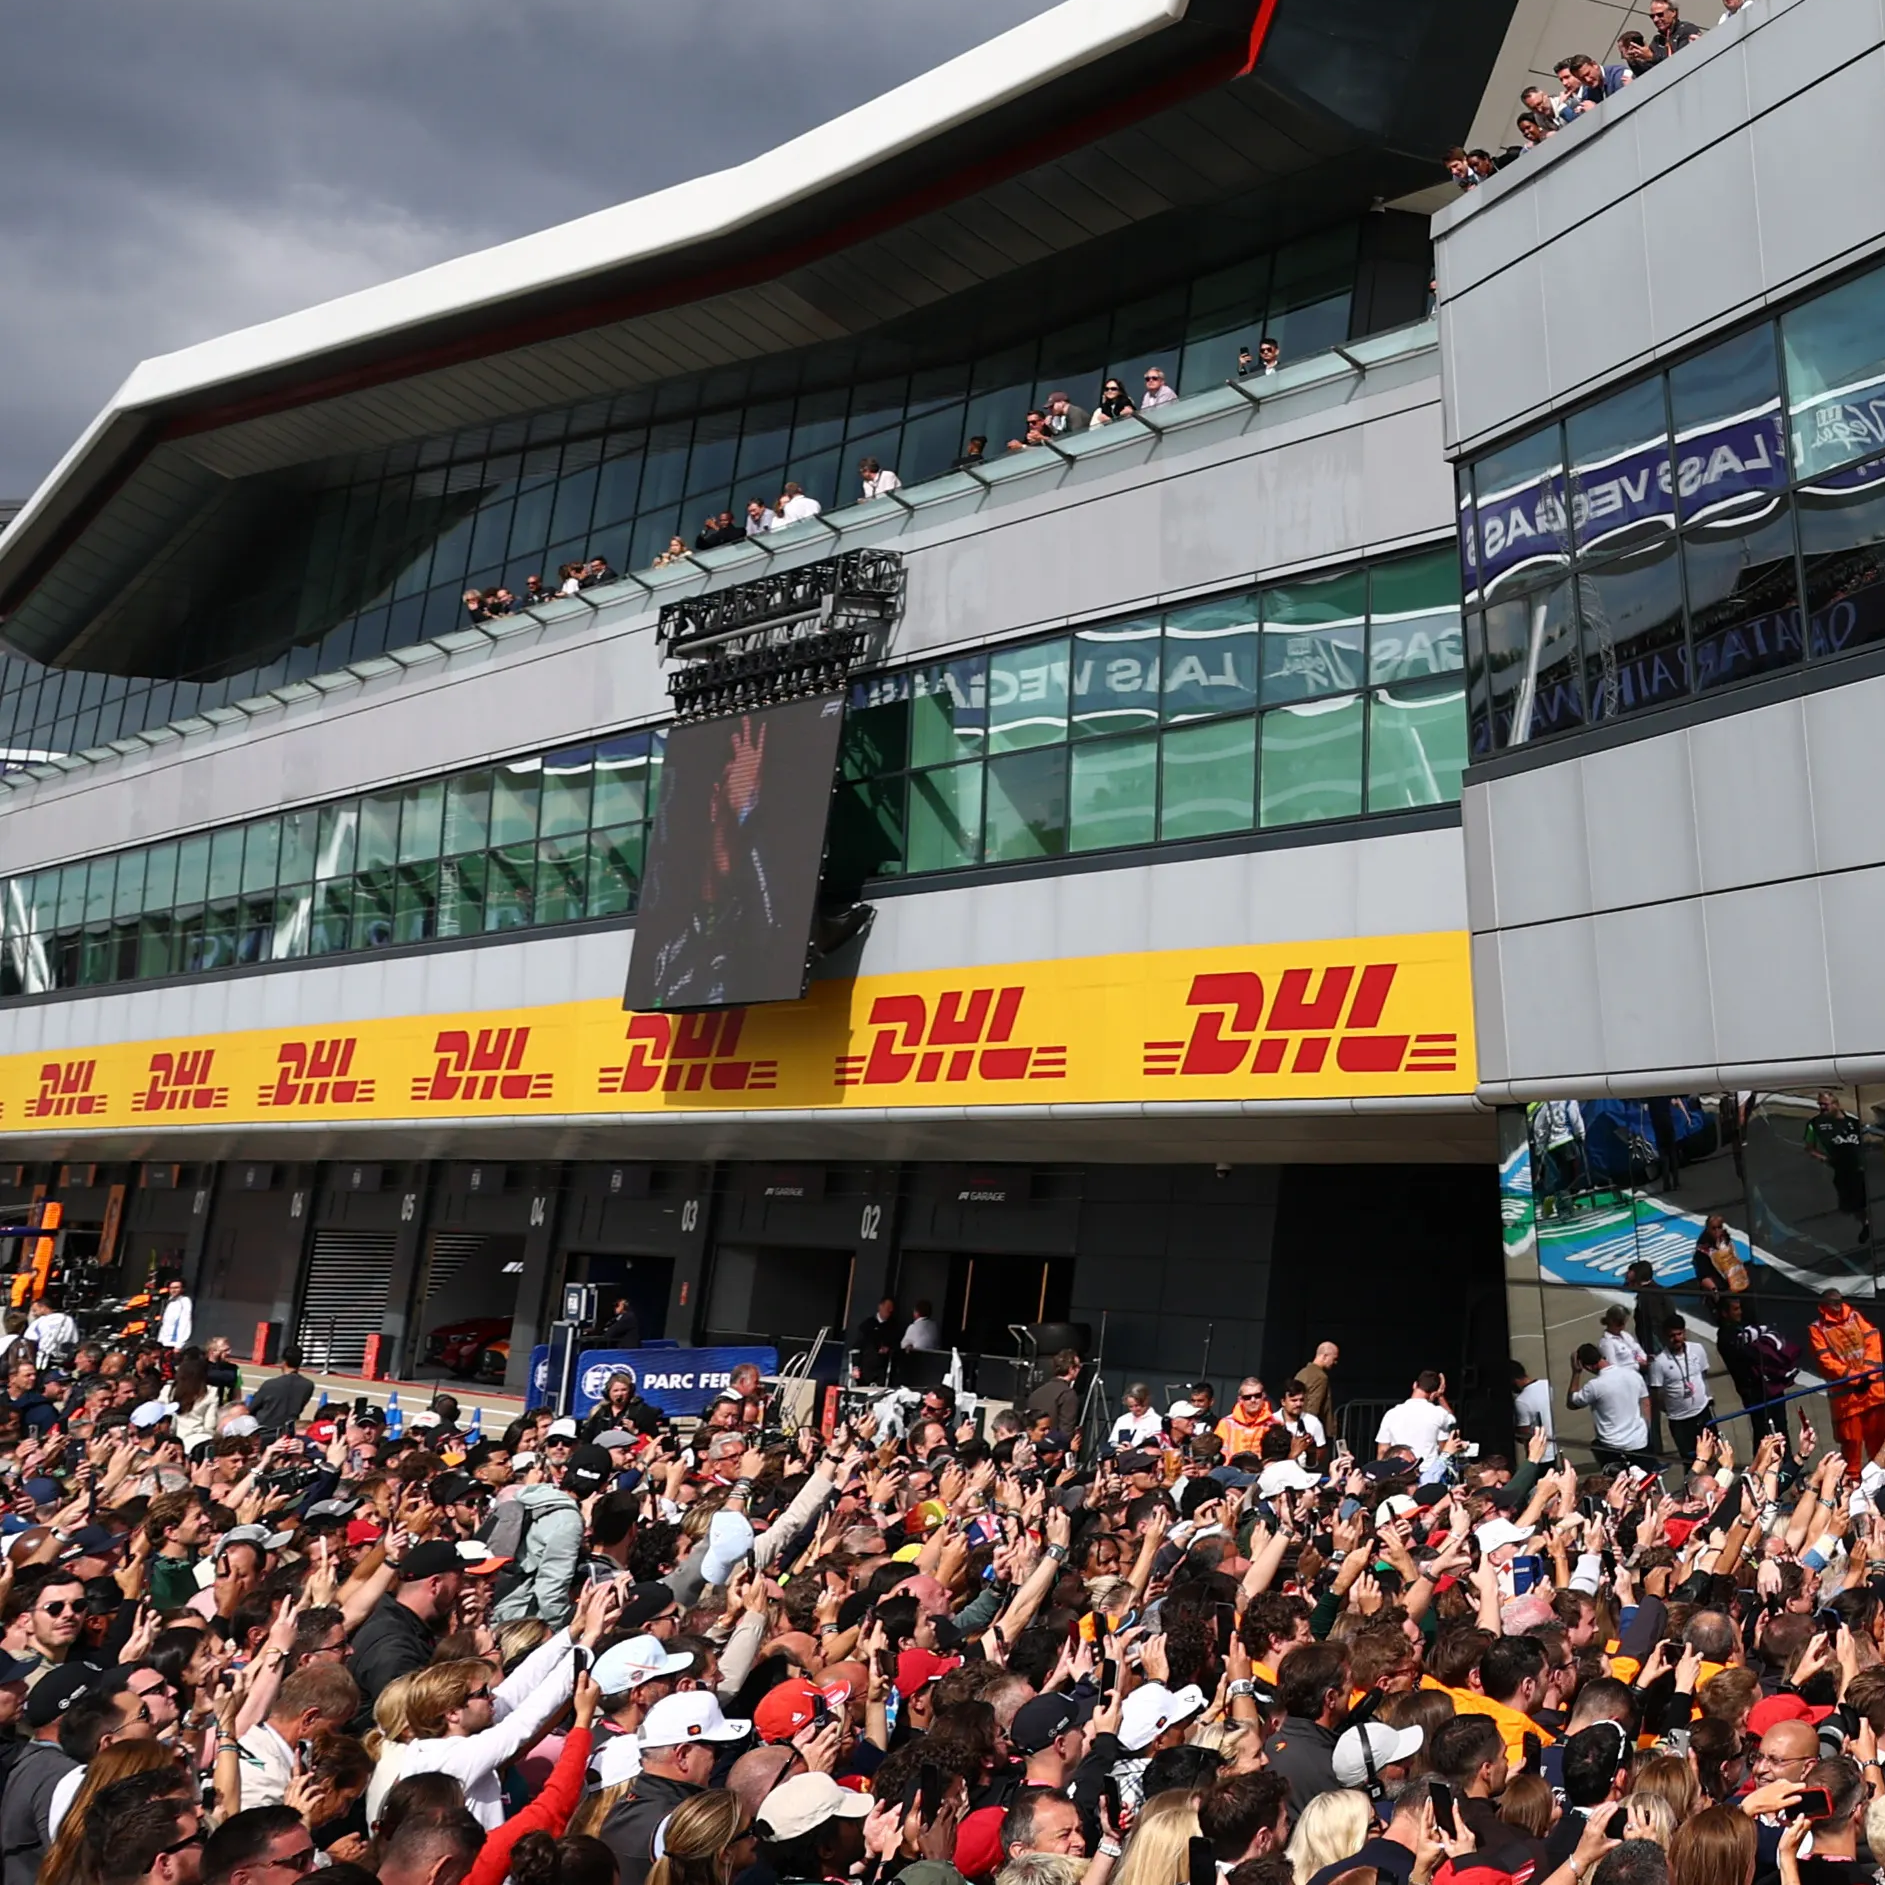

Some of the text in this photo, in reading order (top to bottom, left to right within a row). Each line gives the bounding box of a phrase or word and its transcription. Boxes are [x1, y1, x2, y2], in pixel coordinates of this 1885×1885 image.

[619, 1005, 750, 1092] DHL
[862, 986, 1033, 1084] DHL
[1180, 963, 1411, 1076] DHL
[36, 1059, 97, 1117] DHL
[145, 1049, 215, 1112] DHL
[272, 1037, 358, 1106] DHL
[428, 1026, 531, 1100] DHL
[530, 1197, 546, 1227] 04
[681, 1200, 699, 1232] 03
[860, 1205, 881, 1240] 02
[969, 1191, 1005, 1202] GARAGE
[643, 1372, 731, 1390] PARC FER
